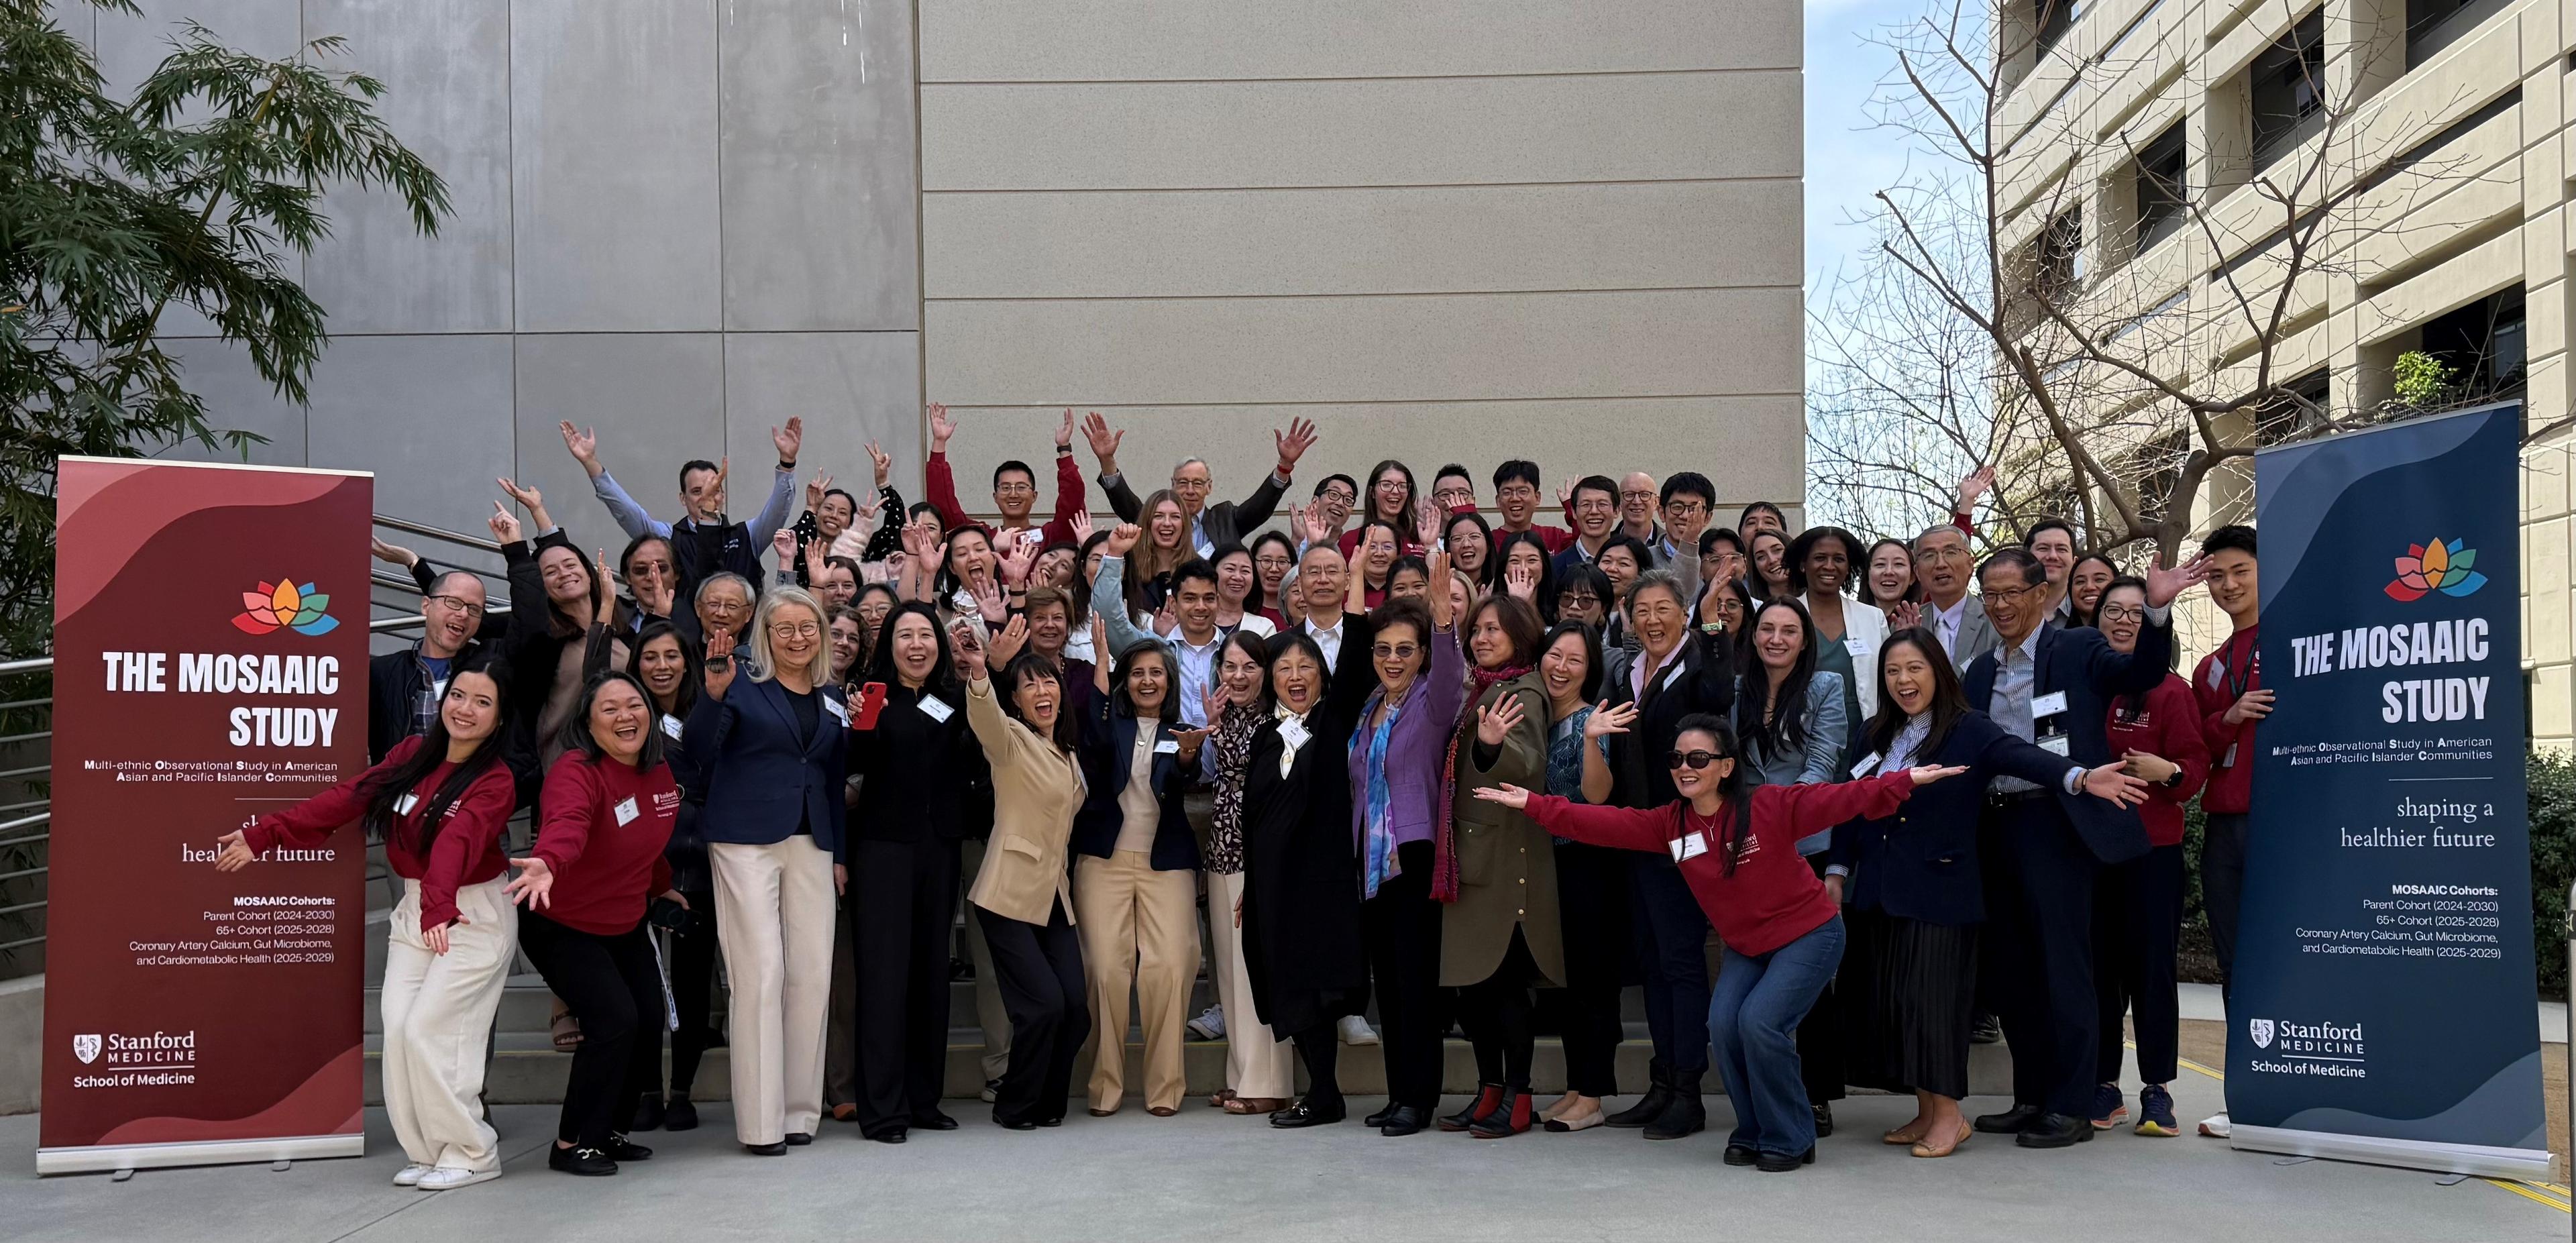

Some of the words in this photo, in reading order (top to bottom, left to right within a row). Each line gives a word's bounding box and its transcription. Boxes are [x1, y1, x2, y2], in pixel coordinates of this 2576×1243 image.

[2292, 633, 2334, 678] THE
[2340, 618, 2488, 670] MOSAAIC
[103, 652, 166, 692] THE
[178, 653, 338, 694] MOSAAIC
[2383, 677, 2489, 723] STUDY
[229, 707, 338, 747] STUDY
[2273, 745, 2316, 755] Multi-ethnic
[2318, 741, 2385, 751] Observational
[2390, 739, 2420, 750] Study
[2424, 739, 2433, 747] in
[2438, 737, 2491, 747] American
[2291, 756, 2313, 765] Asian
[2316, 755, 2332, 764] and
[2335, 753, 2369, 763] Pacific
[2372, 752, 2414, 761] Islander
[2418, 751, 2493, 761] Communities
[85, 760, 151, 770] Multi-ethnic
[155, 760, 233, 770] Observational
[236, 761, 268, 772] Study
[272, 761, 281, 770] in
[285, 761, 337, 771] American
[117, 772, 148, 781] Asian
[152, 772, 172, 781] and
[176, 772, 214, 782] Pacific
[217, 772, 262, 782] Islander
[266, 772, 337, 782] Communities
[2398, 797, 2477, 823] shaping
[2484, 804, 2493, 816] a
[2341, 827, 2426, 847] healthier
[2434, 826, 2494, 847] future
[182, 843, 269, 863] healr
[276, 845, 335, 861] future
[2392, 885, 2448, 895] MOSAAIC
[2449, 885, 2498, 896] Cohorts:
[234, 896, 288, 906] MOSAAIC
[289, 896, 335, 906] Cohorts:
[2363, 900, 2394, 910] Parent
[2396, 900, 2430, 910] Cohort
[2434, 900, 2498, 912] (2024-2030)
[204, 912, 235, 920] Parent
[237, 911, 270, 920] Cohort
[274, 910, 335, 921] (2024-2030)
[2377, 916, 2395, 925] 65+
[2398, 916, 2432, 926] Cohort
[2435, 916, 2499, 928] (2025-2028)
[216, 926, 235, 934] 65+
[238, 925, 271, 934] Cohort
[274, 924, 335, 935] (2025-2028)
[2296, 928, 2338, 939] Coronary
[2340, 929, 2368, 940] Artery
[2371, 930, 2413, 941] Calcium,
[2415, 932, 2433, 941] Gut
[2436, 932, 2498, 944] Microbiome,
[129, 941, 175, 951] Coronary
[178, 940, 208, 951] Artery
[210, 940, 252, 950] Calcium,
[254, 940, 271, 949] Gut
[274, 939, 333, 949] Microbiome,
[2303, 943, 2320, 952] and
[2322, 943, 2400, 955] Cardiometabolic
[2402, 947, 2434, 957] Health
[2436, 947, 2501, 959] (2025-2029)
[137, 955, 155, 965] and
[158, 955, 237, 965] Cardiometabolic
[240, 954, 271, 963] Health
[274, 953, 334, 964] (2025-2029)
[2281, 1020, 2363, 1040] Stanford
[108, 1031, 195, 1049] Stanford
[2282, 1039, 2363, 1054] MEDICINE
[108, 1050, 195, 1063] MEDICINE
[2252, 1061, 2292, 1073] School
[2295, 1063, 2307, 1074] of
[2310, 1064, 2365, 1077] Medicine
[74, 1075, 118, 1087] School
[121, 1074, 134, 1085] of
[138, 1073, 195, 1085] Medicine
